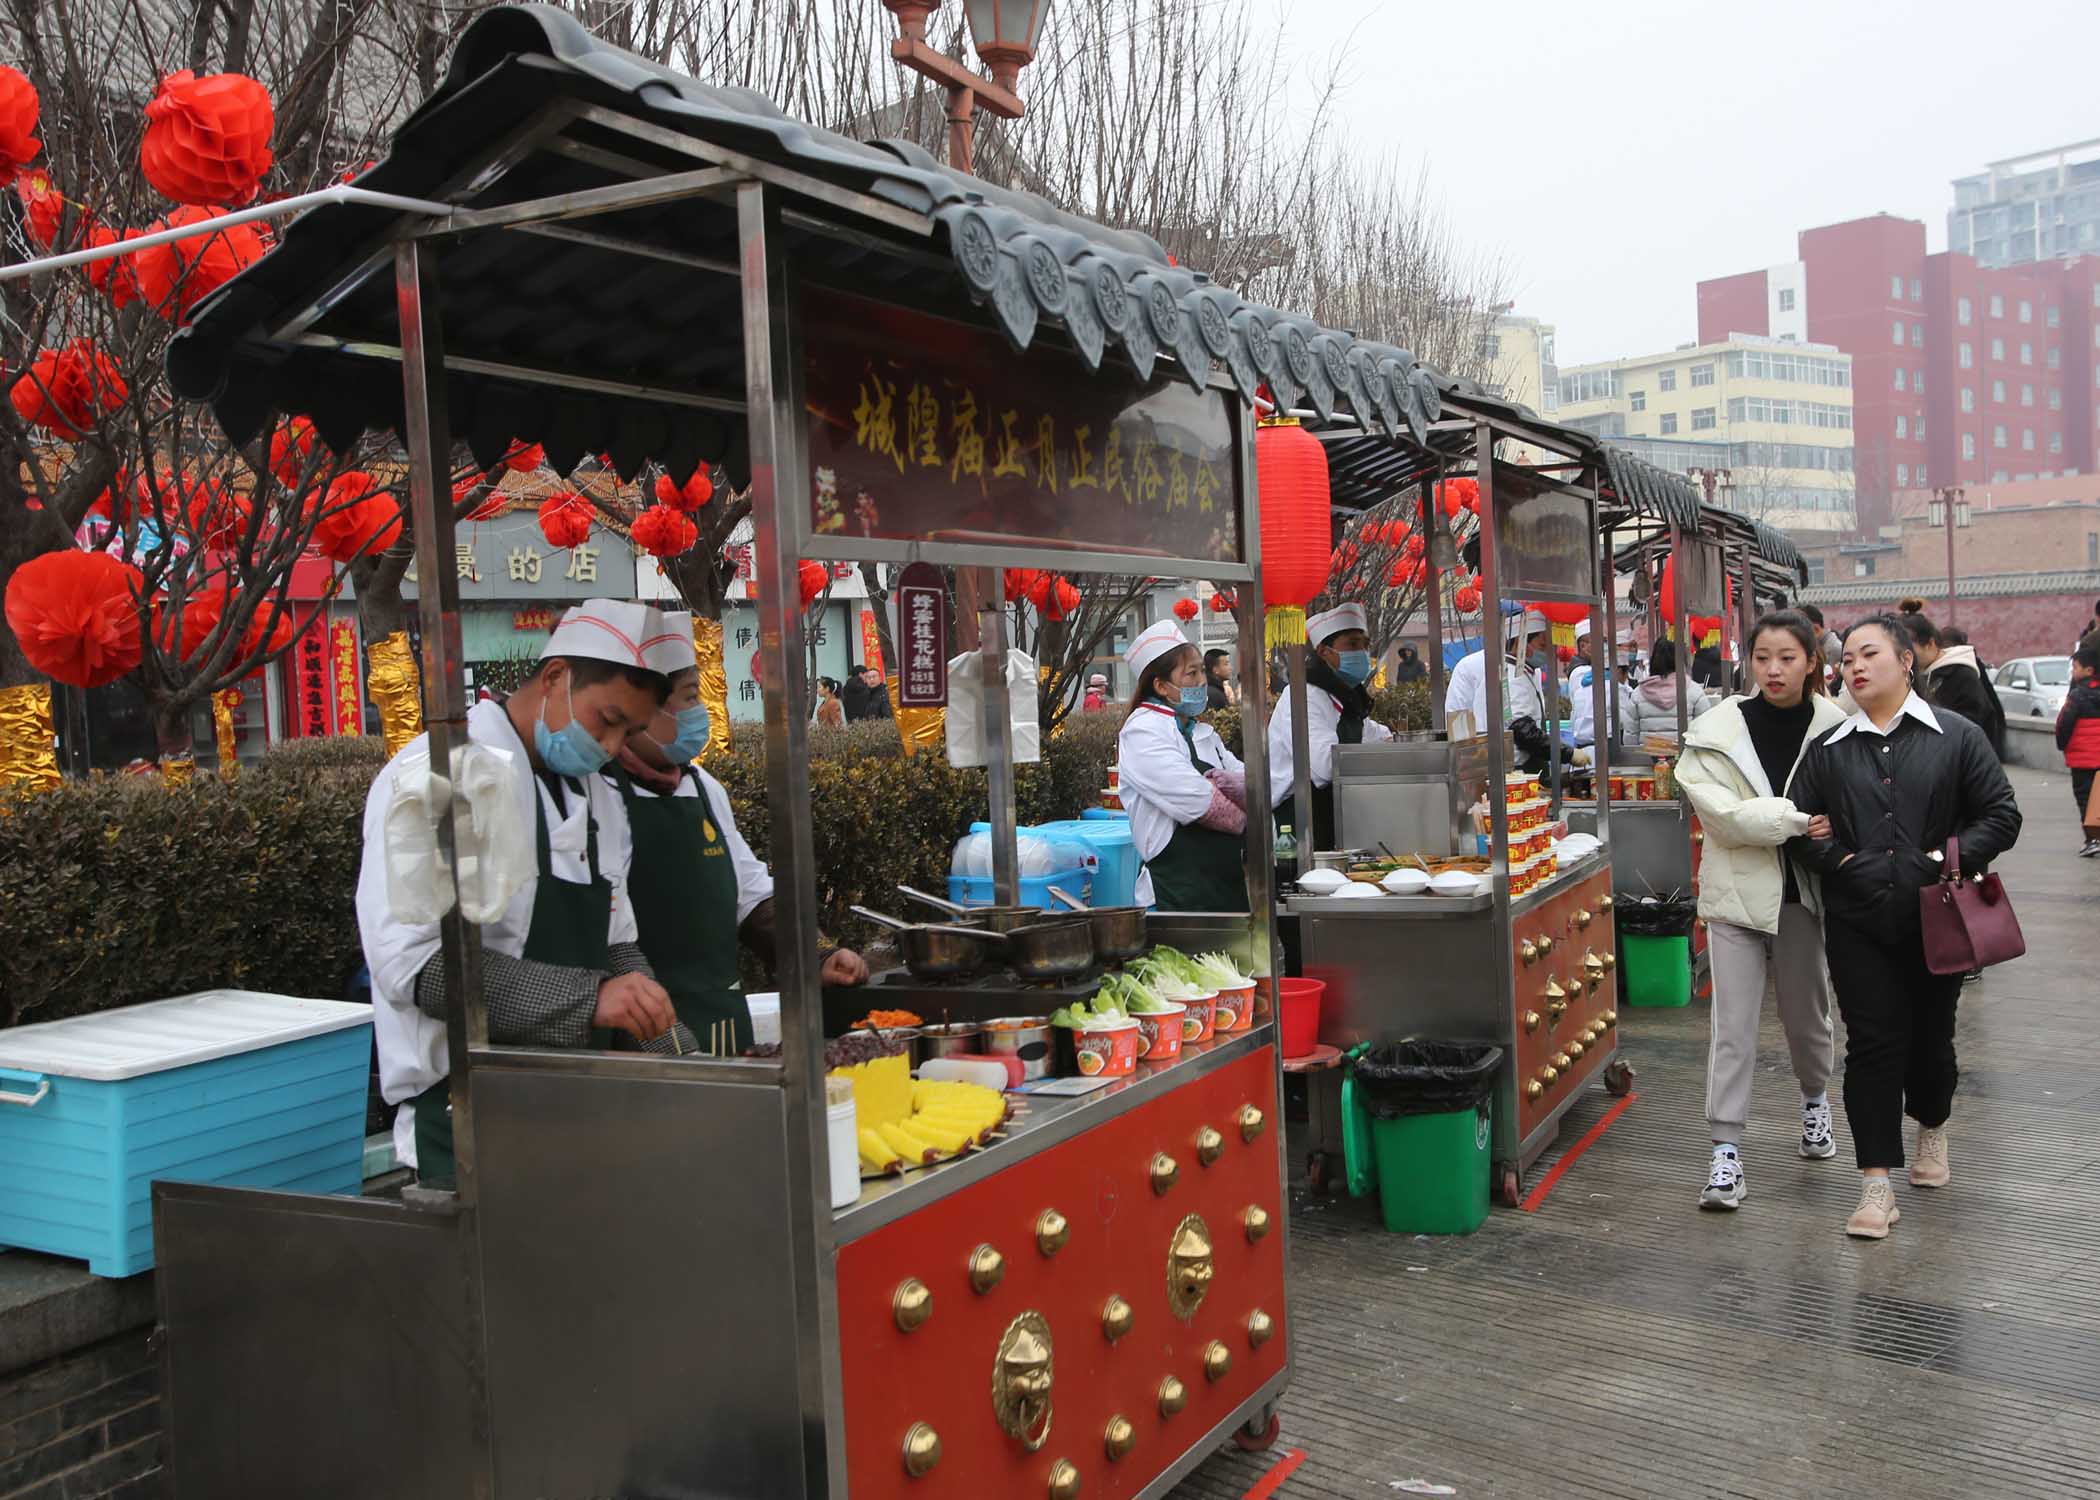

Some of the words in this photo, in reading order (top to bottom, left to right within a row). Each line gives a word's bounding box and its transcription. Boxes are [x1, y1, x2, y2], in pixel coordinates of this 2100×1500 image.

[853, 374, 1221, 513] 城隍庙正月正民俗庙会
